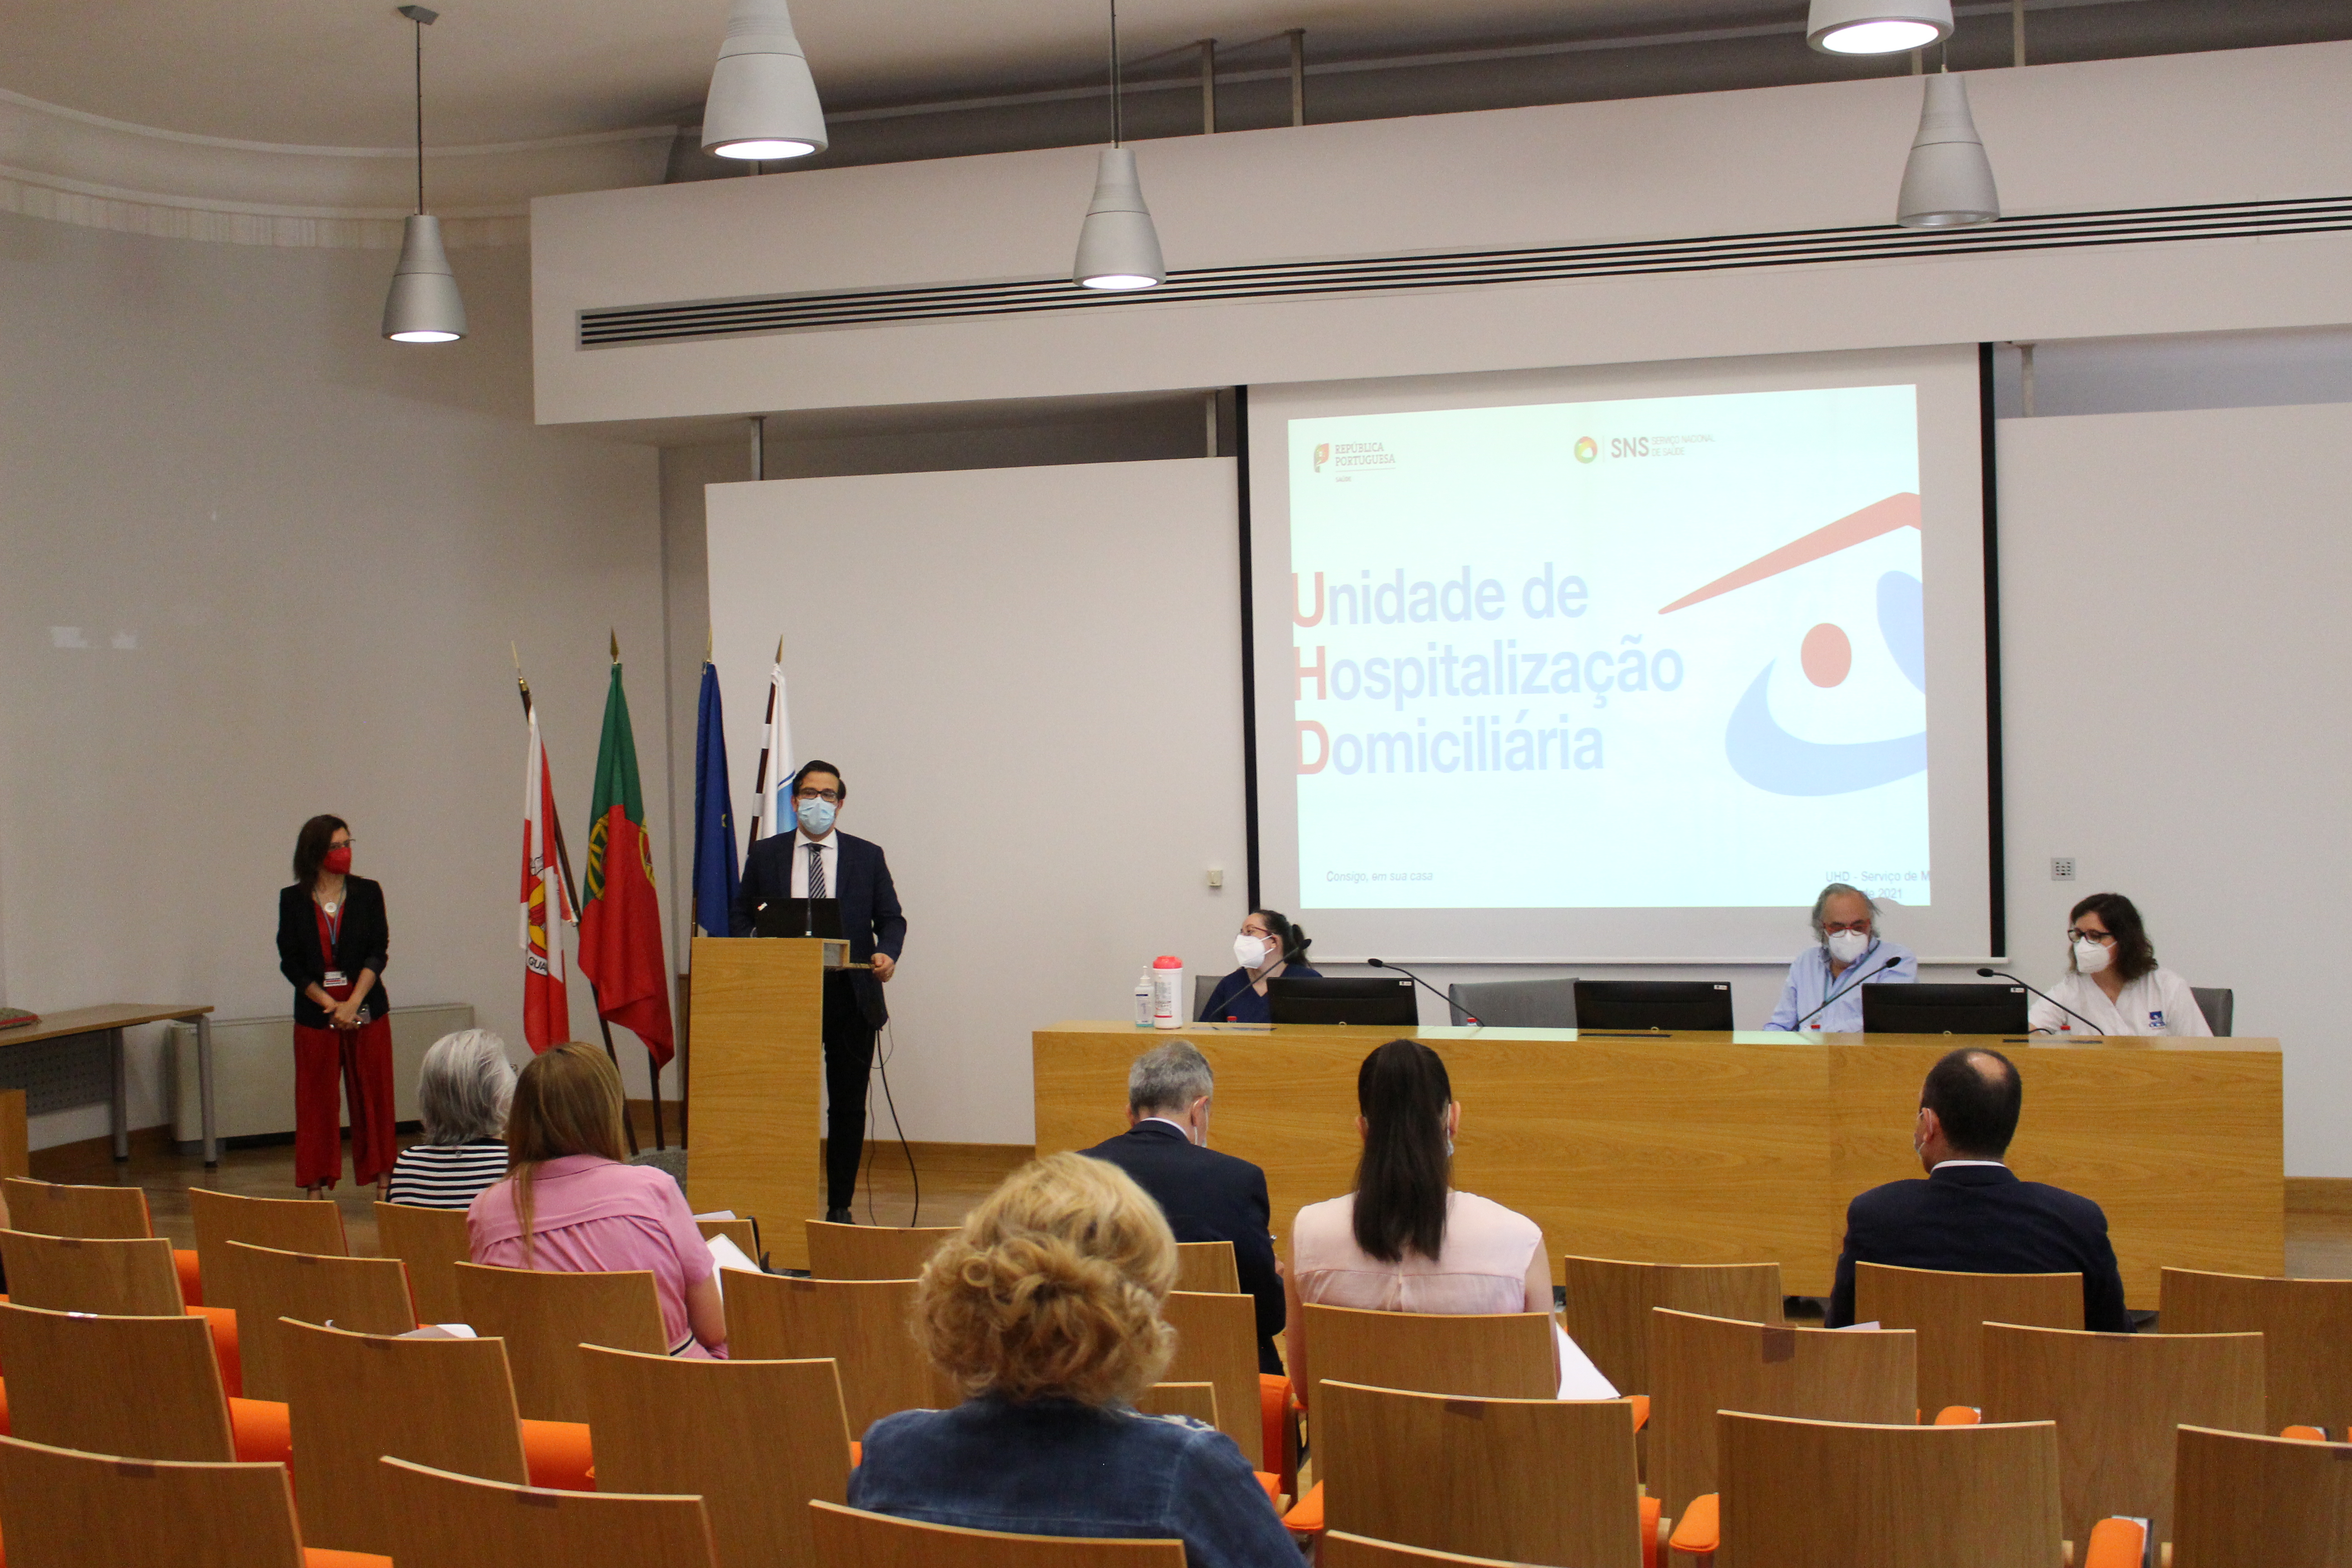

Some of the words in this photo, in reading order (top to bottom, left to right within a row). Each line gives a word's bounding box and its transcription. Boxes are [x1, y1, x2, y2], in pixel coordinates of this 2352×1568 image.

[1335, 441, 1384, 454] REPÚBLICA
[1611, 437, 1649, 458] SNS
[1652, 448, 1661, 456] DE
[1335, 454, 1396, 466] PORTUGUESA
[1292, 565, 1505, 627] Unidade
[1522, 562, 1588, 619] de
[1294, 634, 1683, 711] Hospitalização
[1296, 709, 1603, 775] Domiciliária
[1327, 871, 1368, 883] Consigo,
[1390, 872, 1407, 881] sua
[1826, 871, 1850, 882] UHD
[1862, 871, 1901, 884] Serviço
[1904, 871, 1917, 881] de
[1878, 888, 1902, 898] 2021
